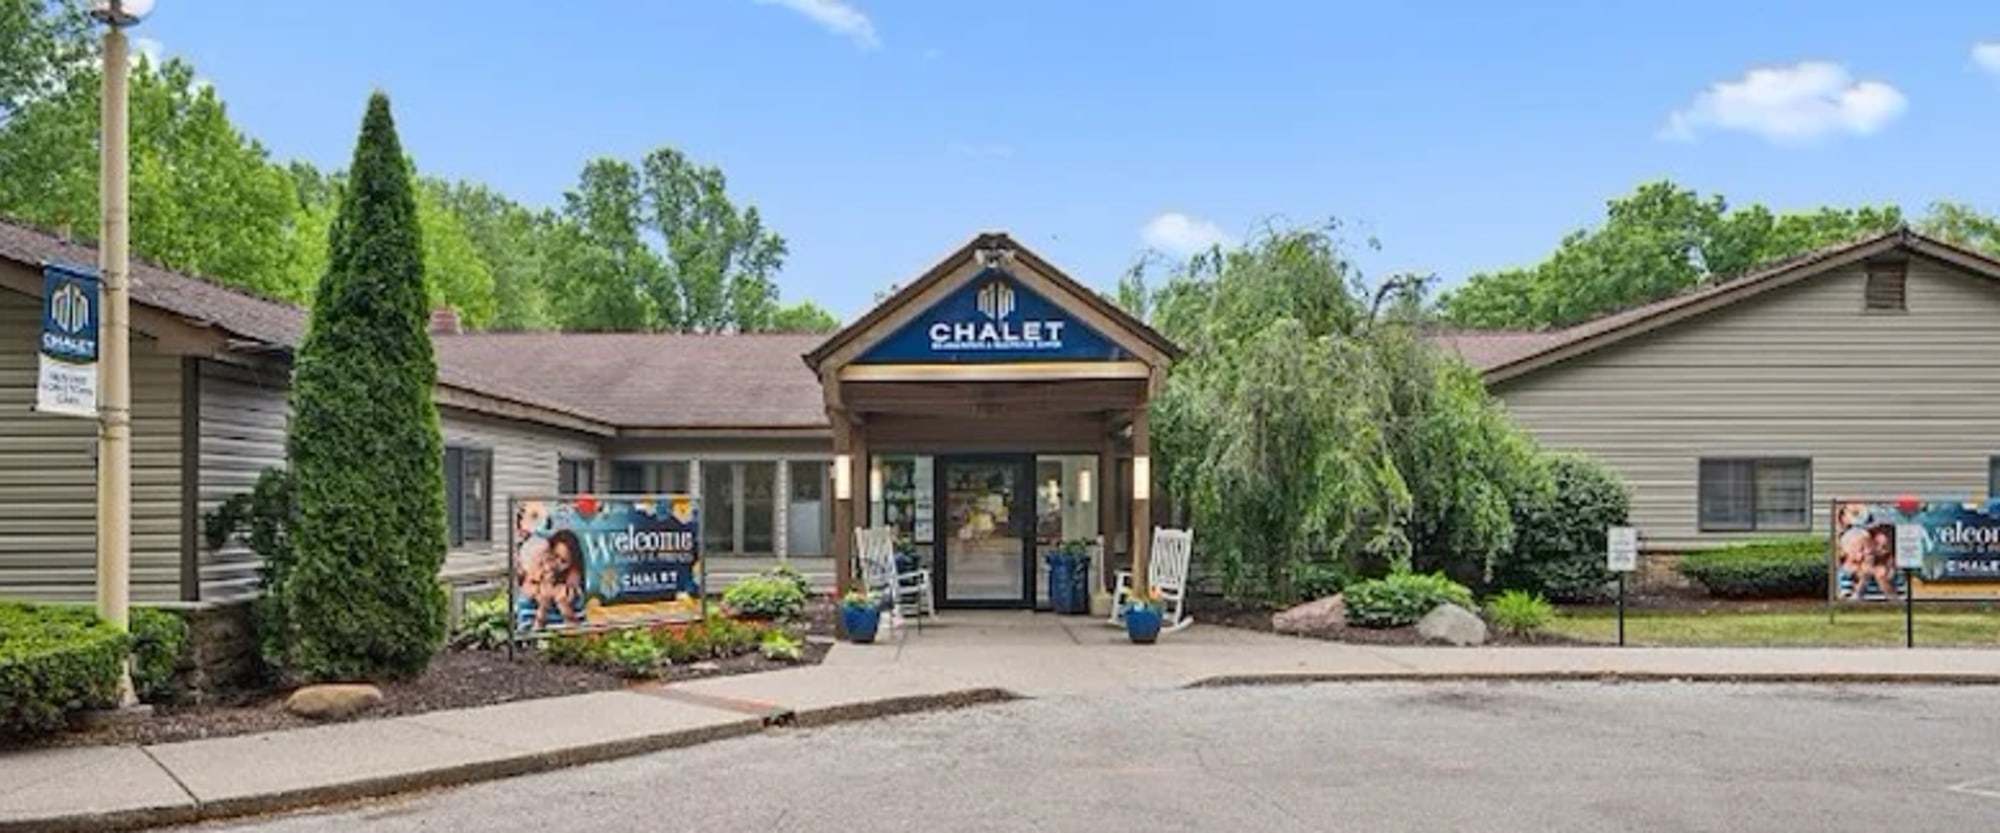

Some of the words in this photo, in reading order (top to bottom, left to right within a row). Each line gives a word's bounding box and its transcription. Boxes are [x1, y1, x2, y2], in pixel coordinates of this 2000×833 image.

[929, 321, 1064, 342] CHALET
[43, 333, 96, 352] CHALET
[584, 523, 693, 564] Welcome
[622, 571, 678, 586] CHALET
